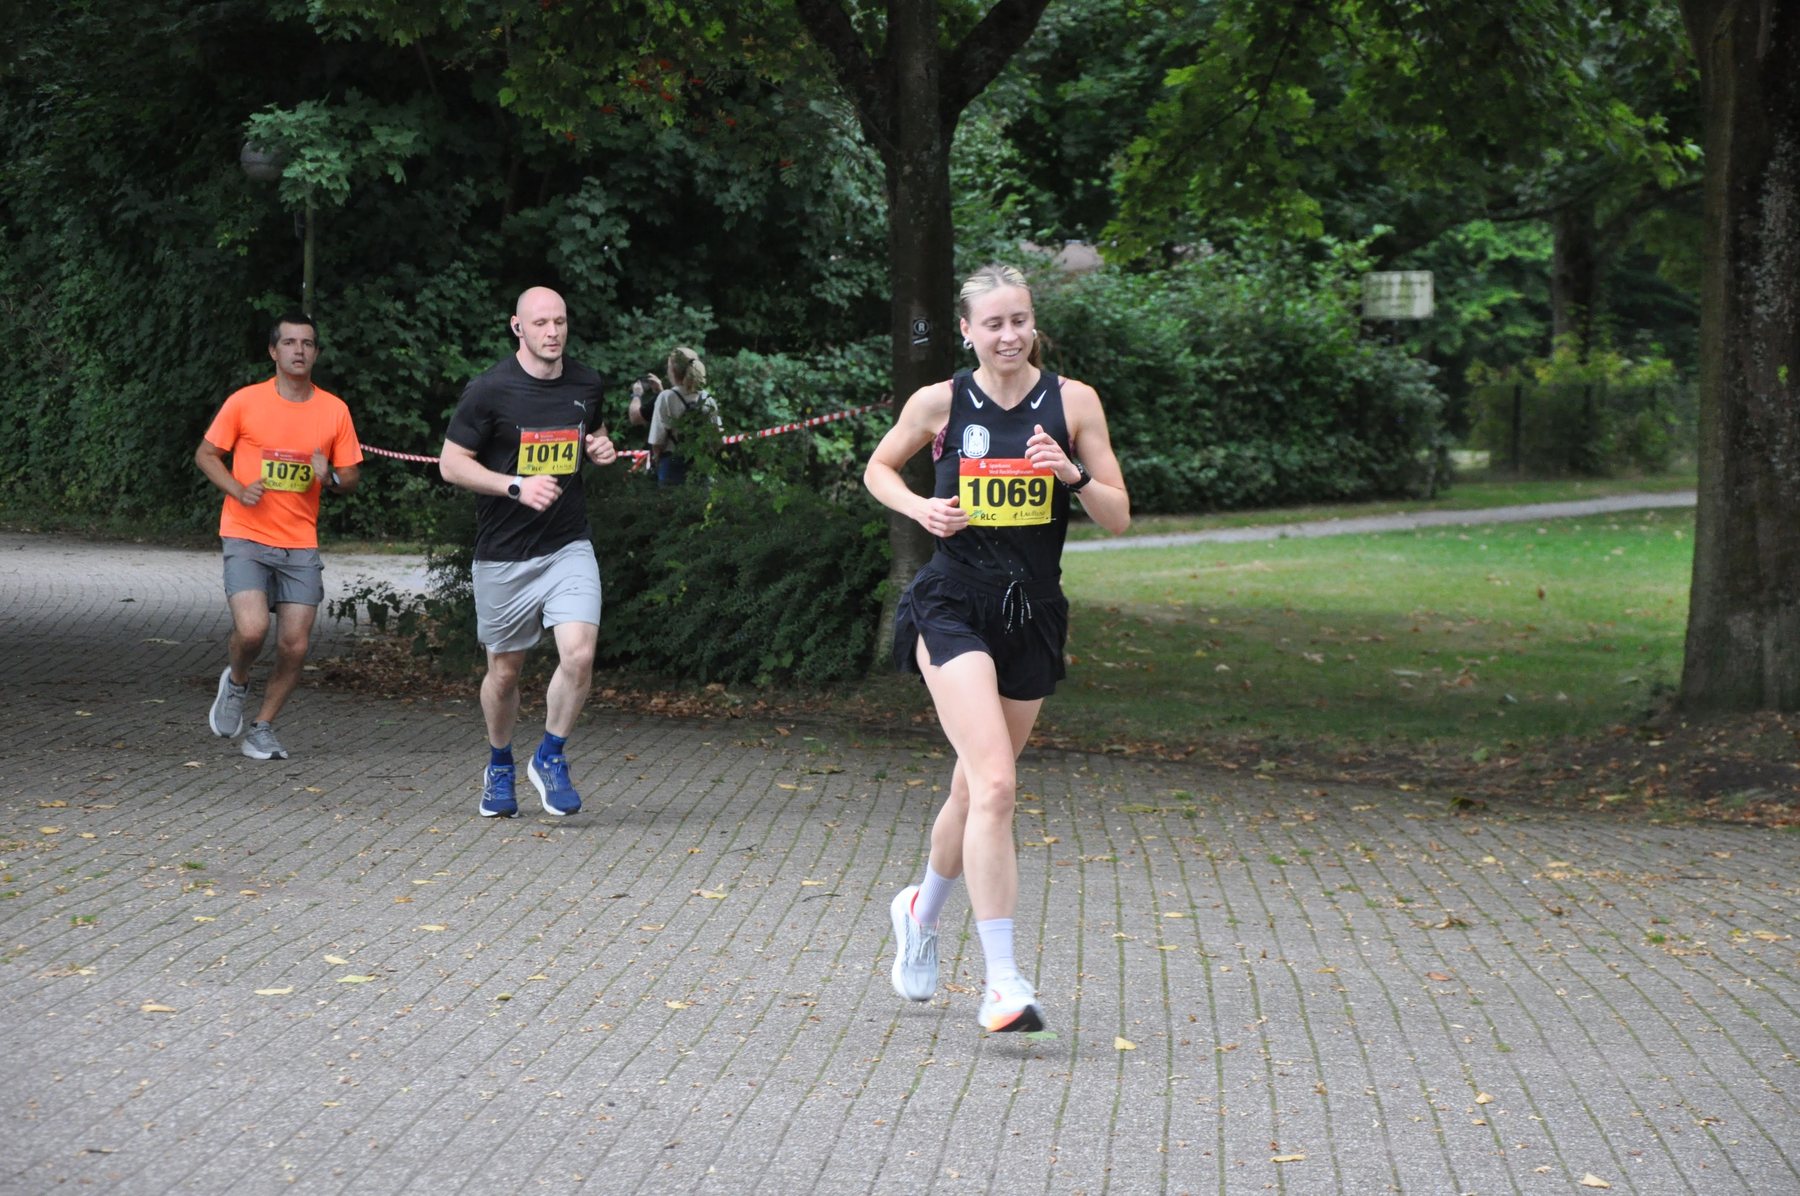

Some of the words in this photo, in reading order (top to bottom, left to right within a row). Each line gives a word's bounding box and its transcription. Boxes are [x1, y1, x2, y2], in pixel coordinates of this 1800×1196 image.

[525, 443, 574, 463] 1014
[266, 461, 311, 482] 1073
[967, 478, 1048, 507] 1069
[980, 513, 997, 521] RLC
